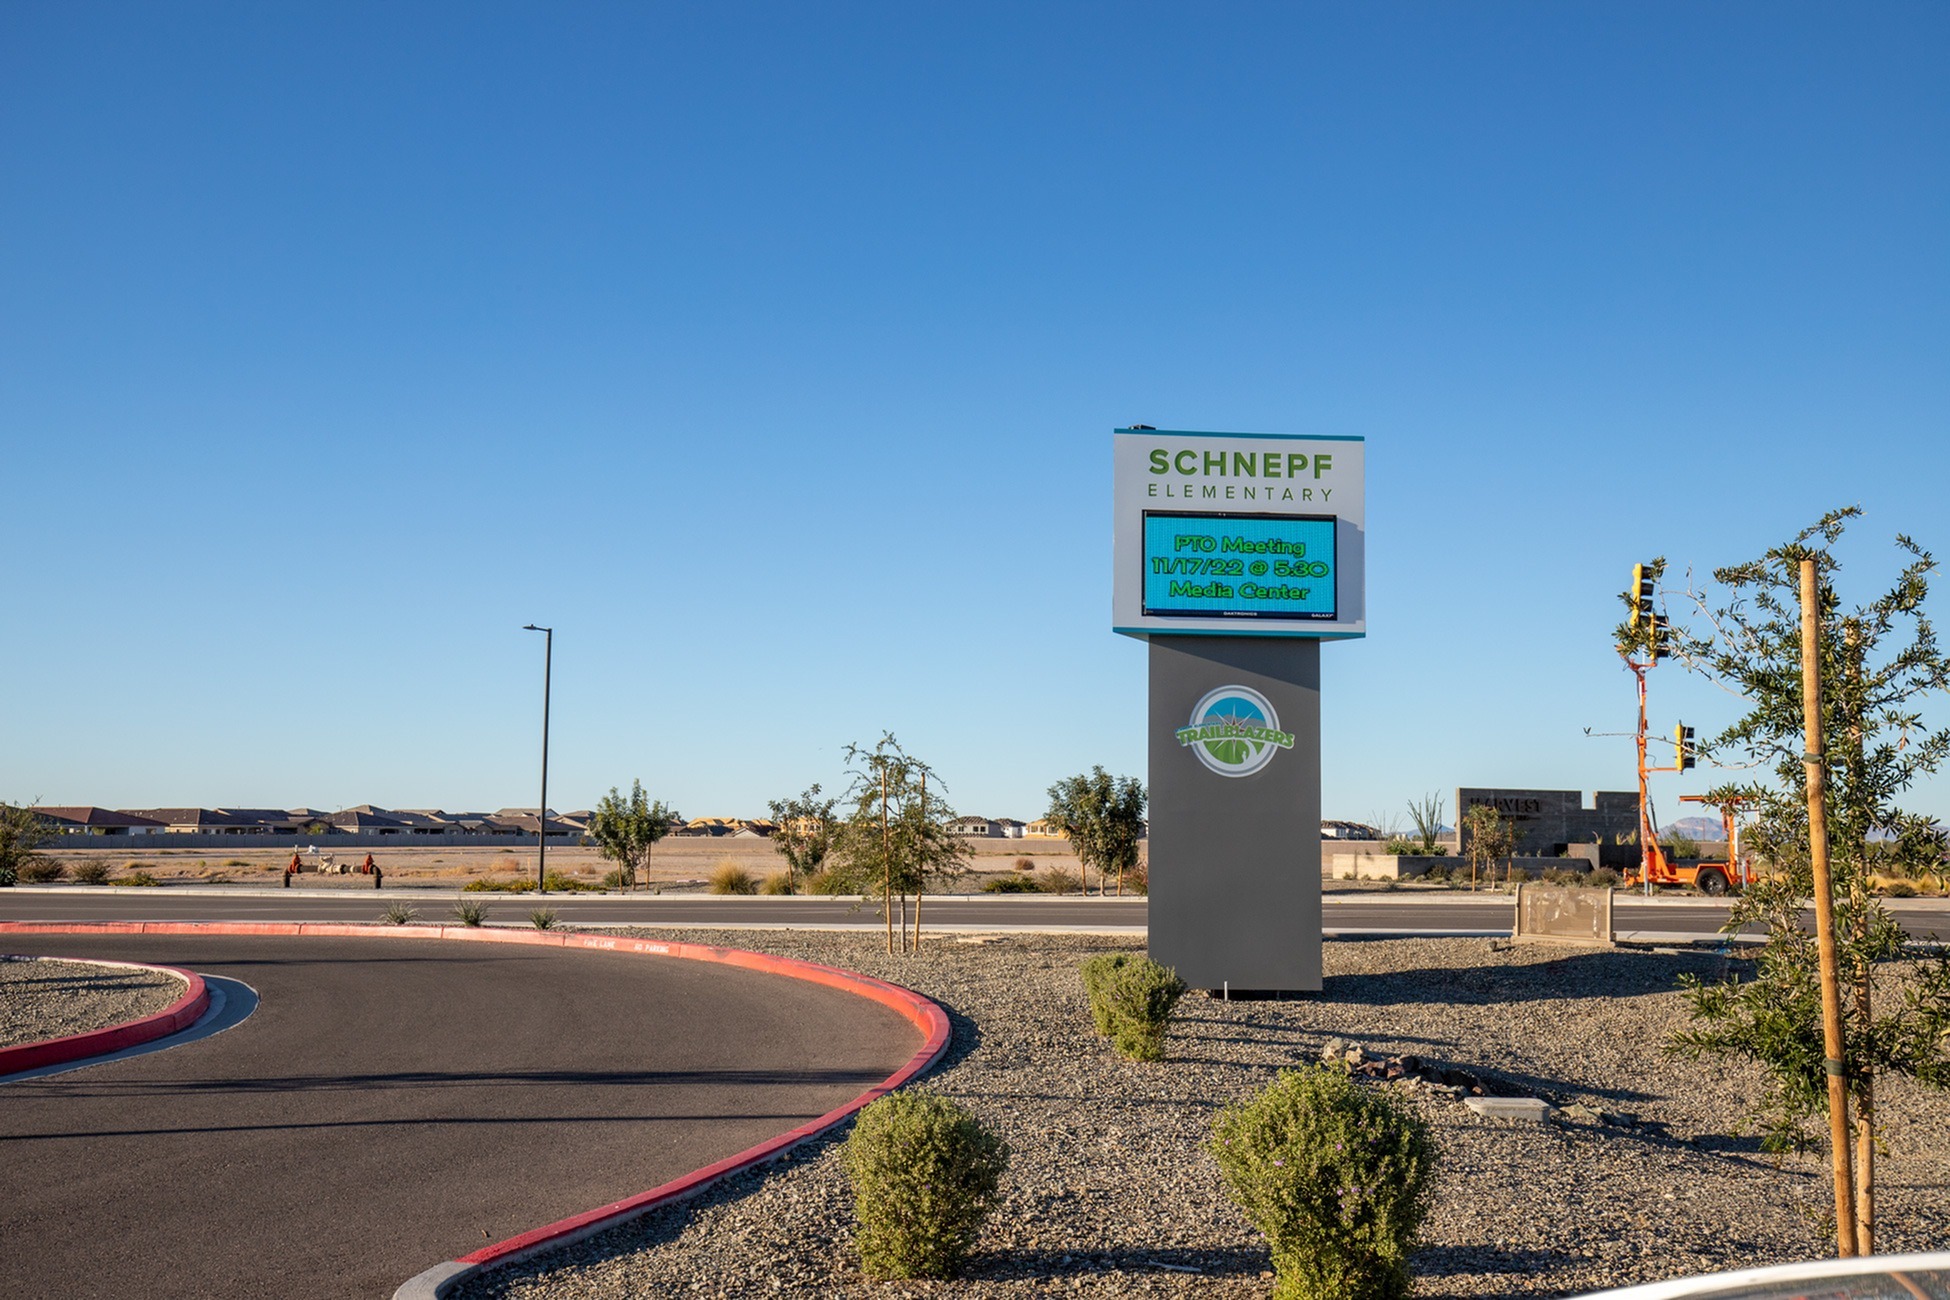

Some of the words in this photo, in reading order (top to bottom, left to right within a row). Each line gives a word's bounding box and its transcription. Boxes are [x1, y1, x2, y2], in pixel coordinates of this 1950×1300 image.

[1149, 448, 1333, 480] SCHNEPF
[1147, 483, 1334, 502] ELEMENTARY
[1174, 534, 1217, 553] PTO
[1221, 536, 1306, 558] Meeting
[1152, 557, 1244, 576] 11/17/22
[1249, 560, 1269, 577] @
[1273, 560, 1329, 578] 5:30
[1169, 580, 1234, 599] Media
[1238, 582, 1311, 600] Center
[1176, 724, 1296, 749] TRAILBLAZERS
